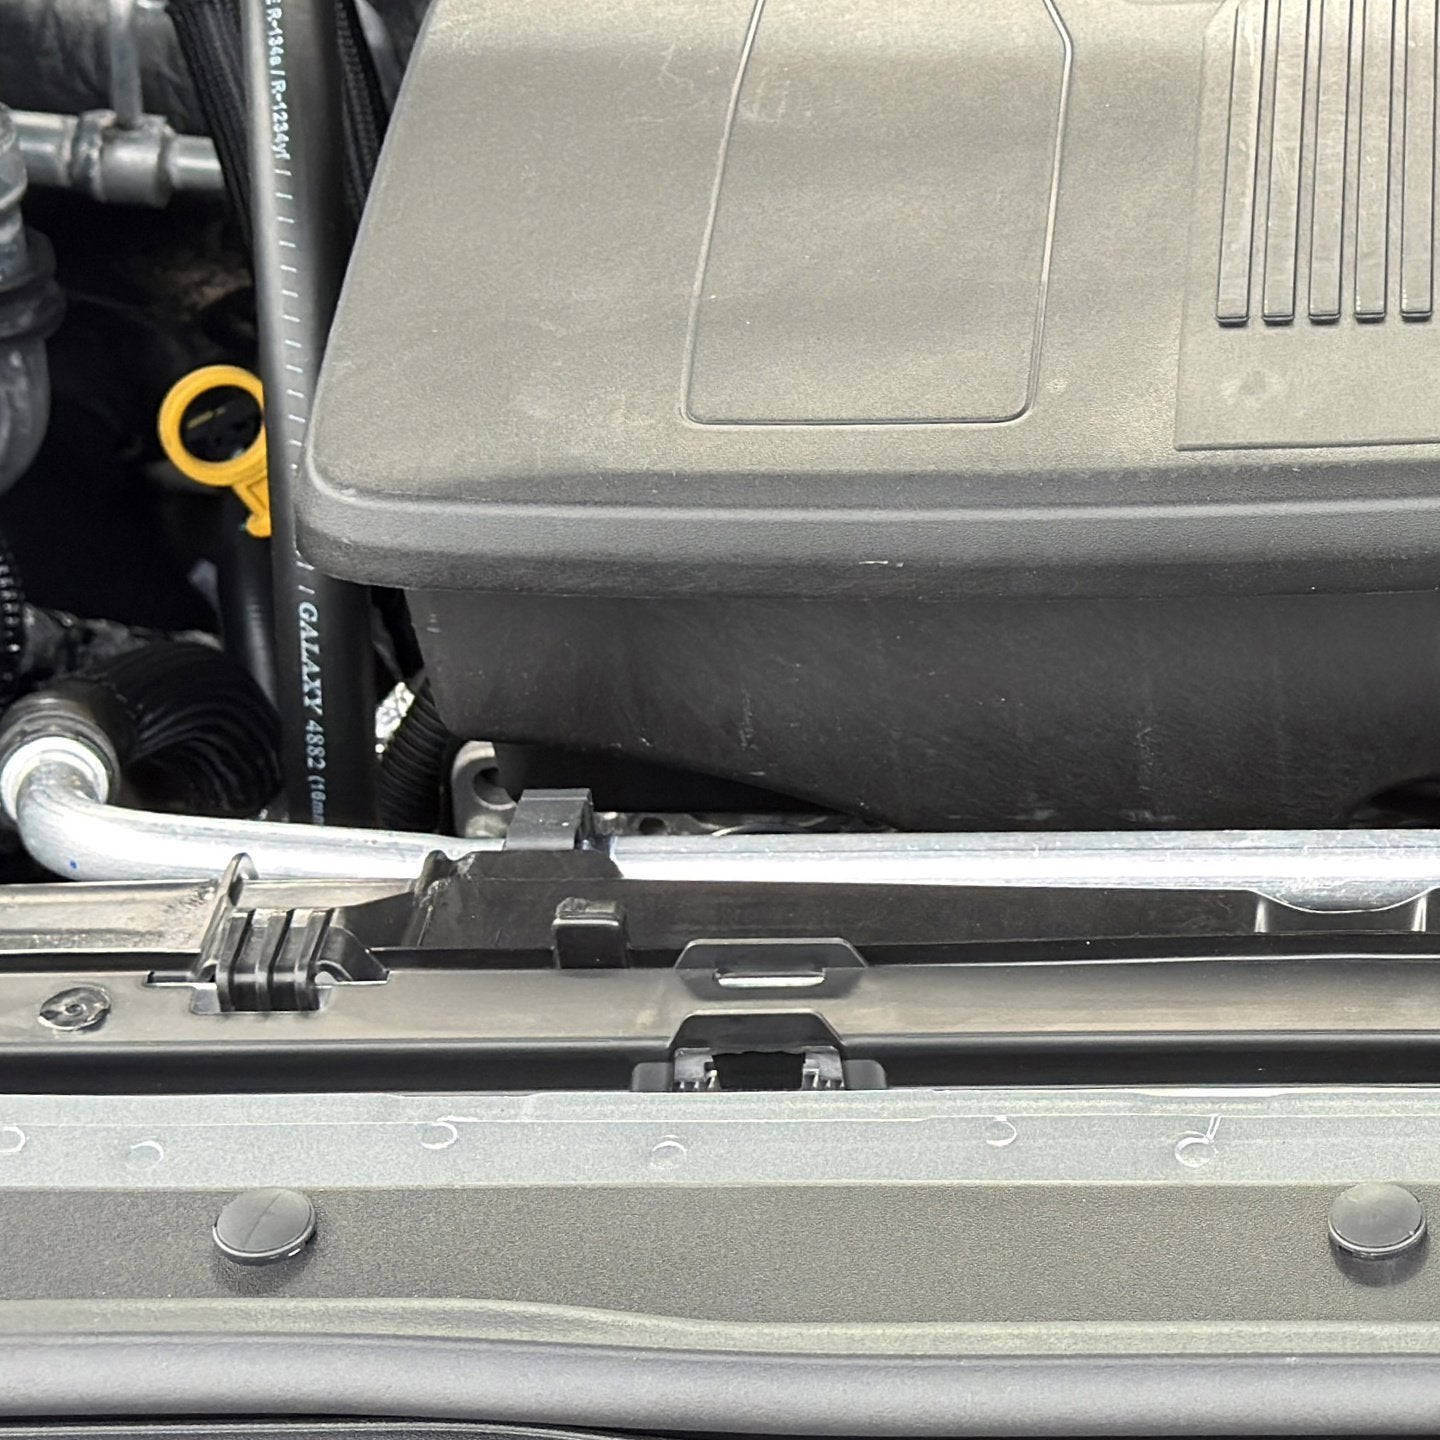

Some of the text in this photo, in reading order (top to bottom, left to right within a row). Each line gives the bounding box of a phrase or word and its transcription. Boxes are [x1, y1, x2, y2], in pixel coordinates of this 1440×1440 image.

[266, 8, 286, 67] R-134a
[271, 79, 292, 160] R-1234yf
[298, 601, 323, 716] GALAXY
[305, 719, 326, 769] 4882
